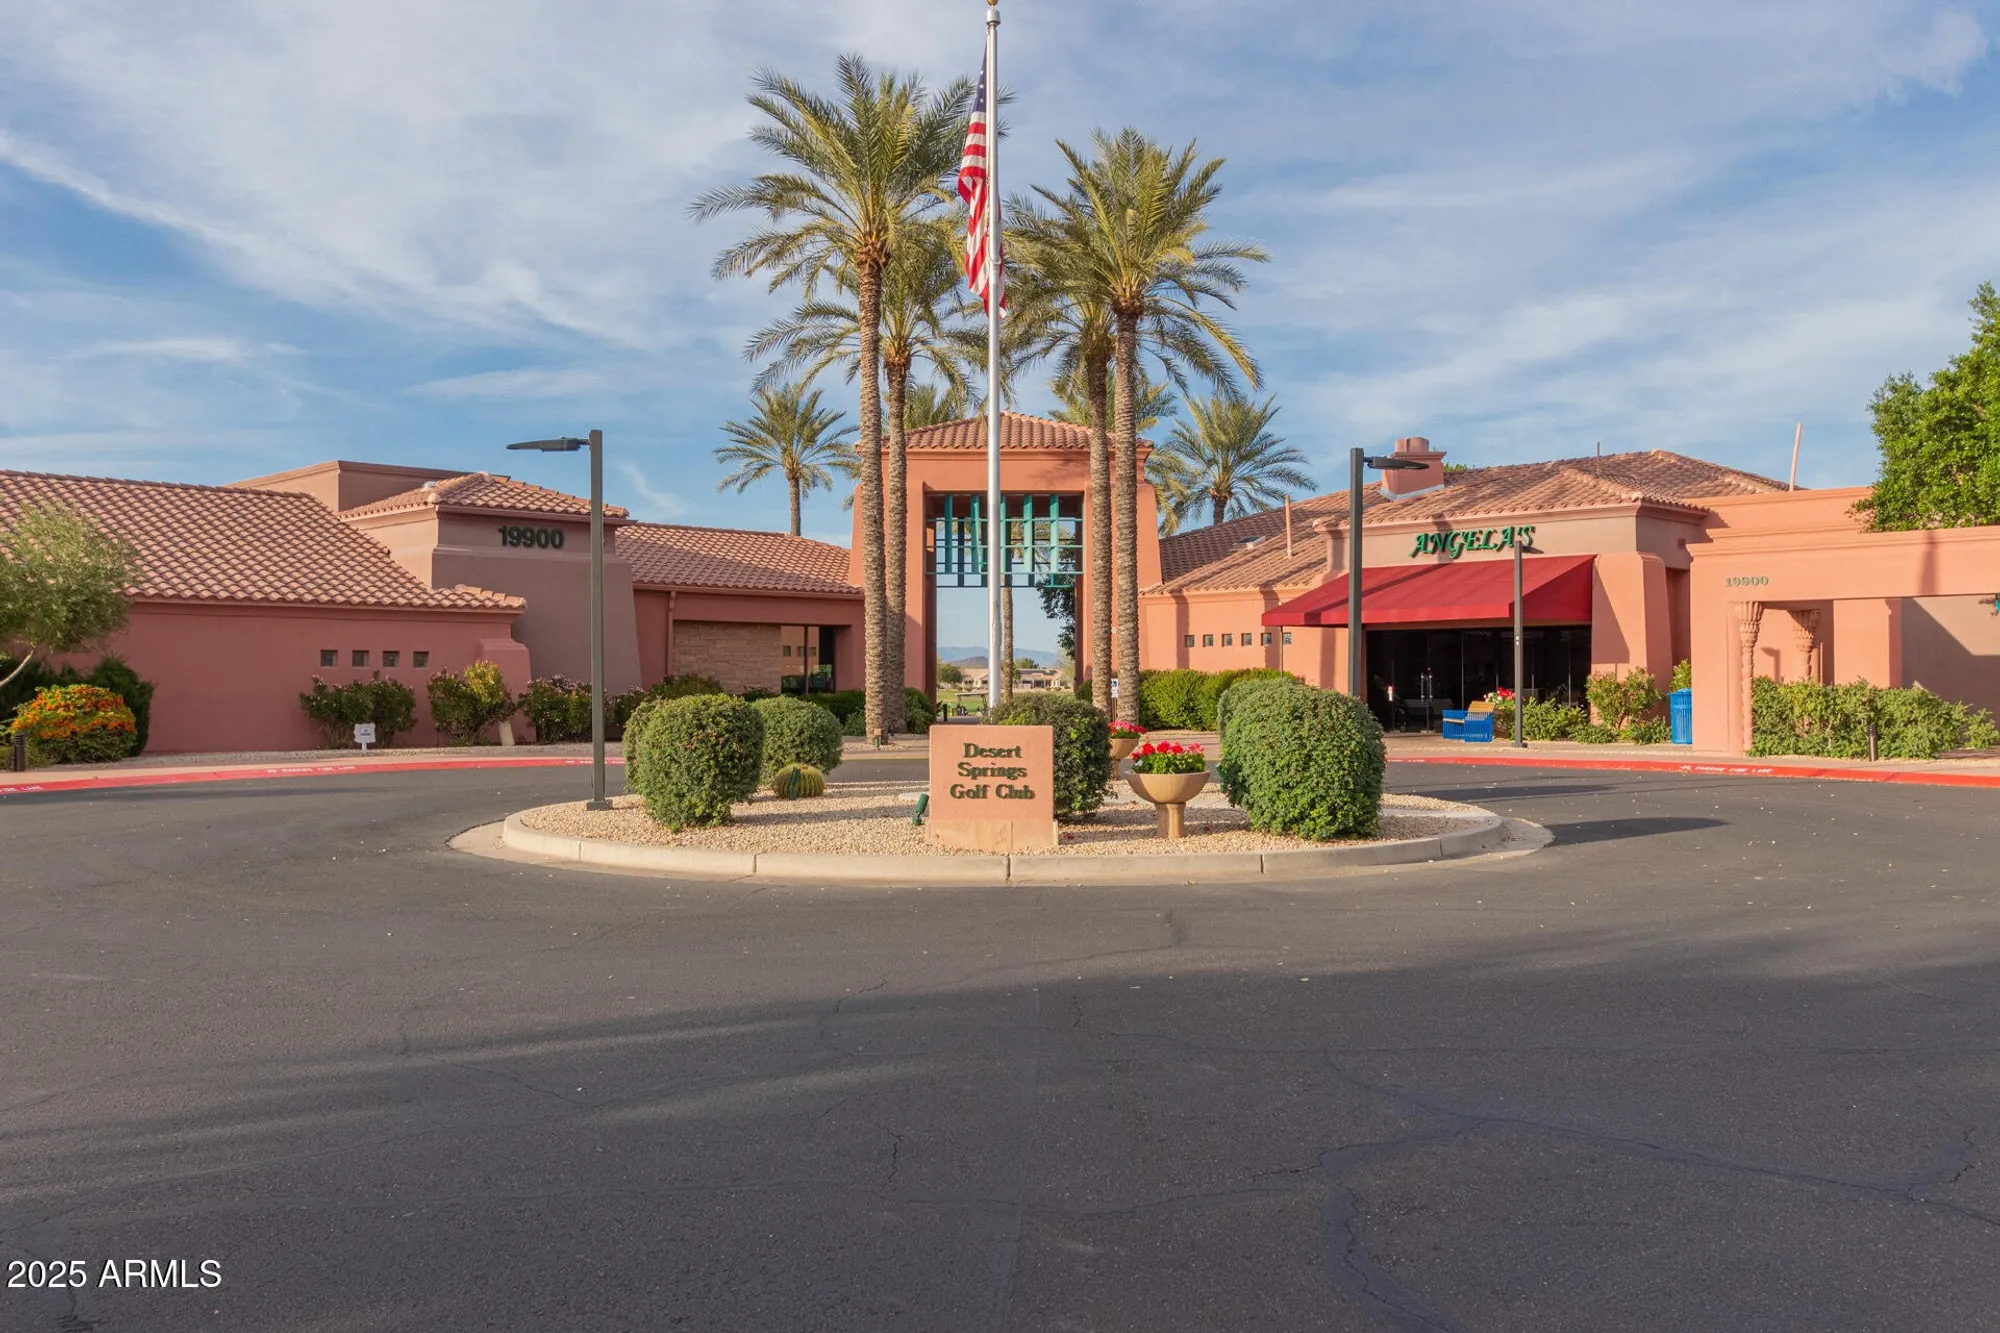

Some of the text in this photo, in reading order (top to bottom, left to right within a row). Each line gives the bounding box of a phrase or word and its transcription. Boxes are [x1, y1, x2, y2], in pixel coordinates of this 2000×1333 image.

[498, 525, 565, 549] 19900
[1725, 576, 1769, 587] 19900
[963, 743, 1023, 758] Desert
[957, 762, 1028, 780] Springs
[950, 784, 1036, 799] Golf Club
